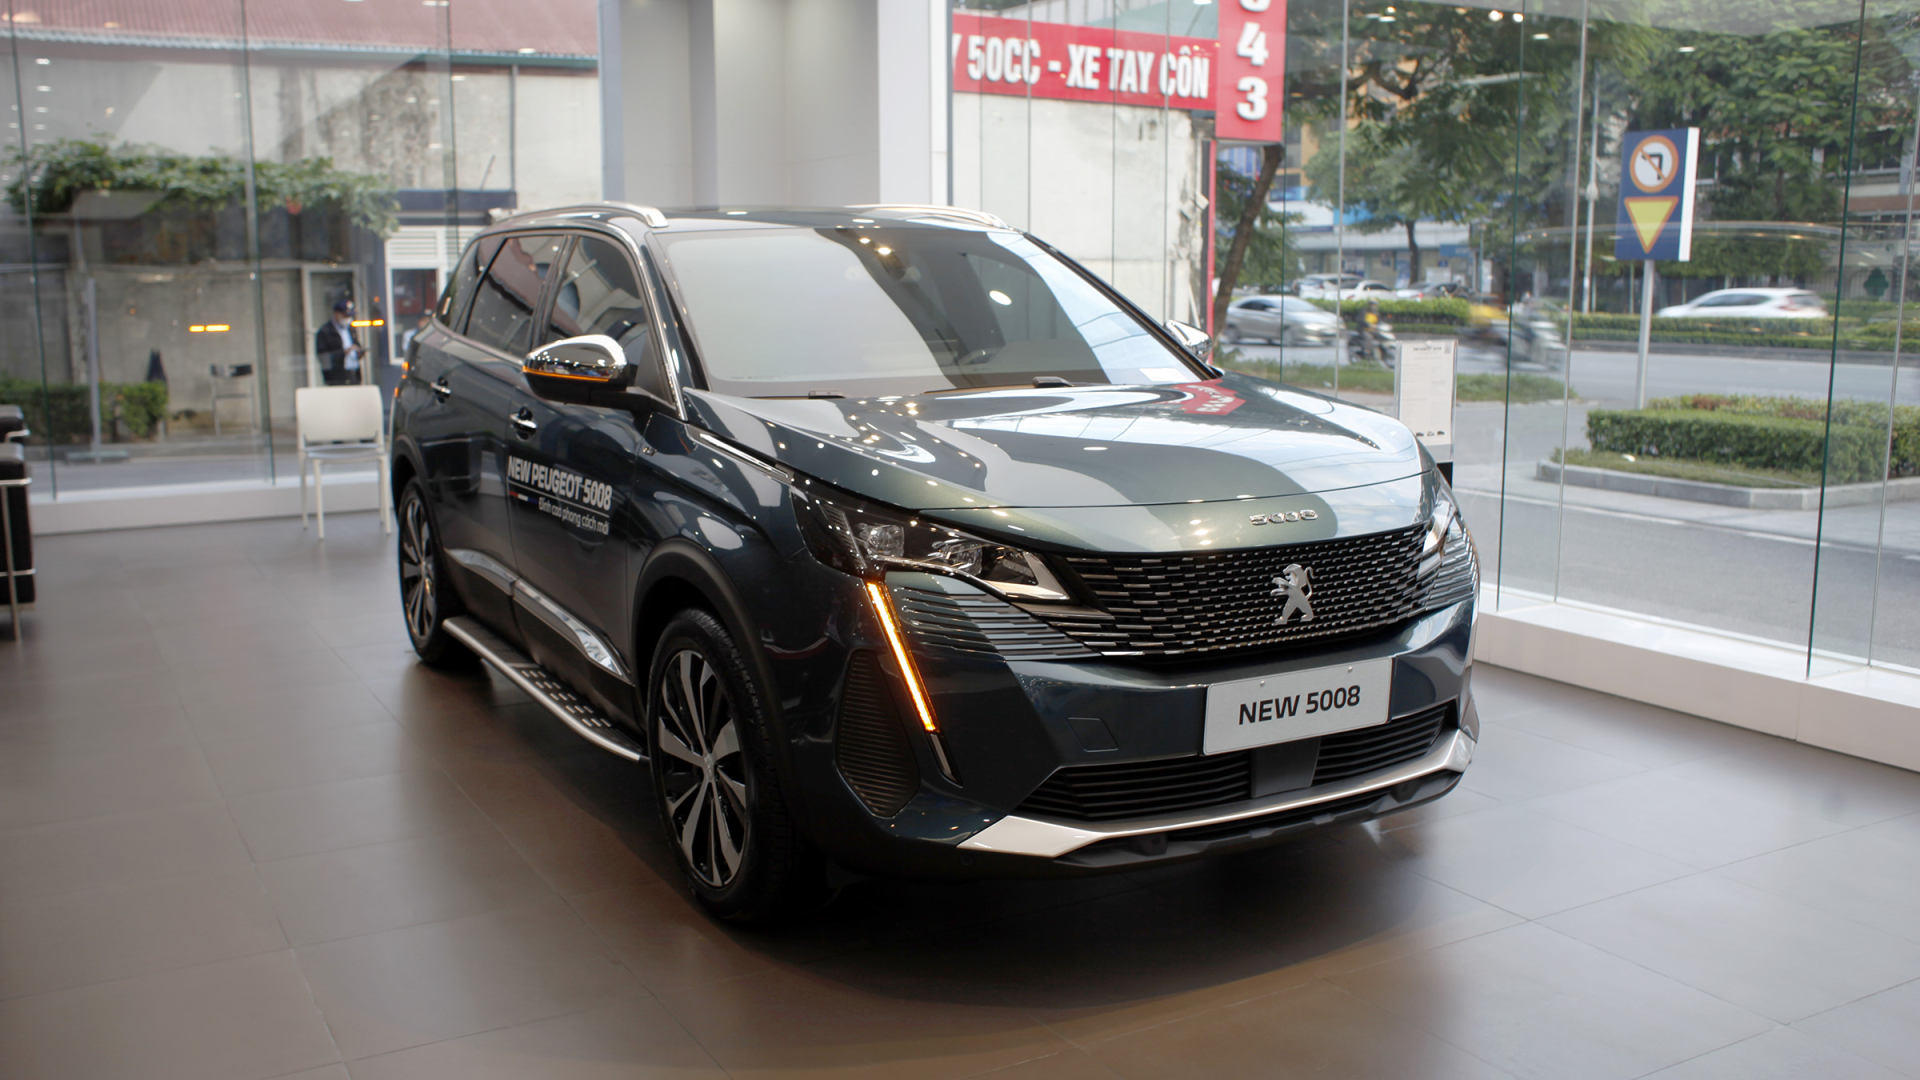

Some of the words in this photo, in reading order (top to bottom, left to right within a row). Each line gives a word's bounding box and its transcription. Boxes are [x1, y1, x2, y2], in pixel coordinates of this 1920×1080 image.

[967, 34, 1041, 85] 50CC
[1066, 44, 1102, 90] XE
[1106, 47, 1155, 94] TAY
[1159, 45, 1210, 99] CÔN
[508, 455, 532, 484] NEW
[531, 462, 583, 500] PEUGEOT
[582, 478, 613, 511] 5008
[561, 507, 581, 528] phong
[581, 514, 597, 531] cách
[1249, 509, 1319, 525] 5008
[1238, 695, 1301, 726] NEW
[1305, 685, 1361, 714] 5008
